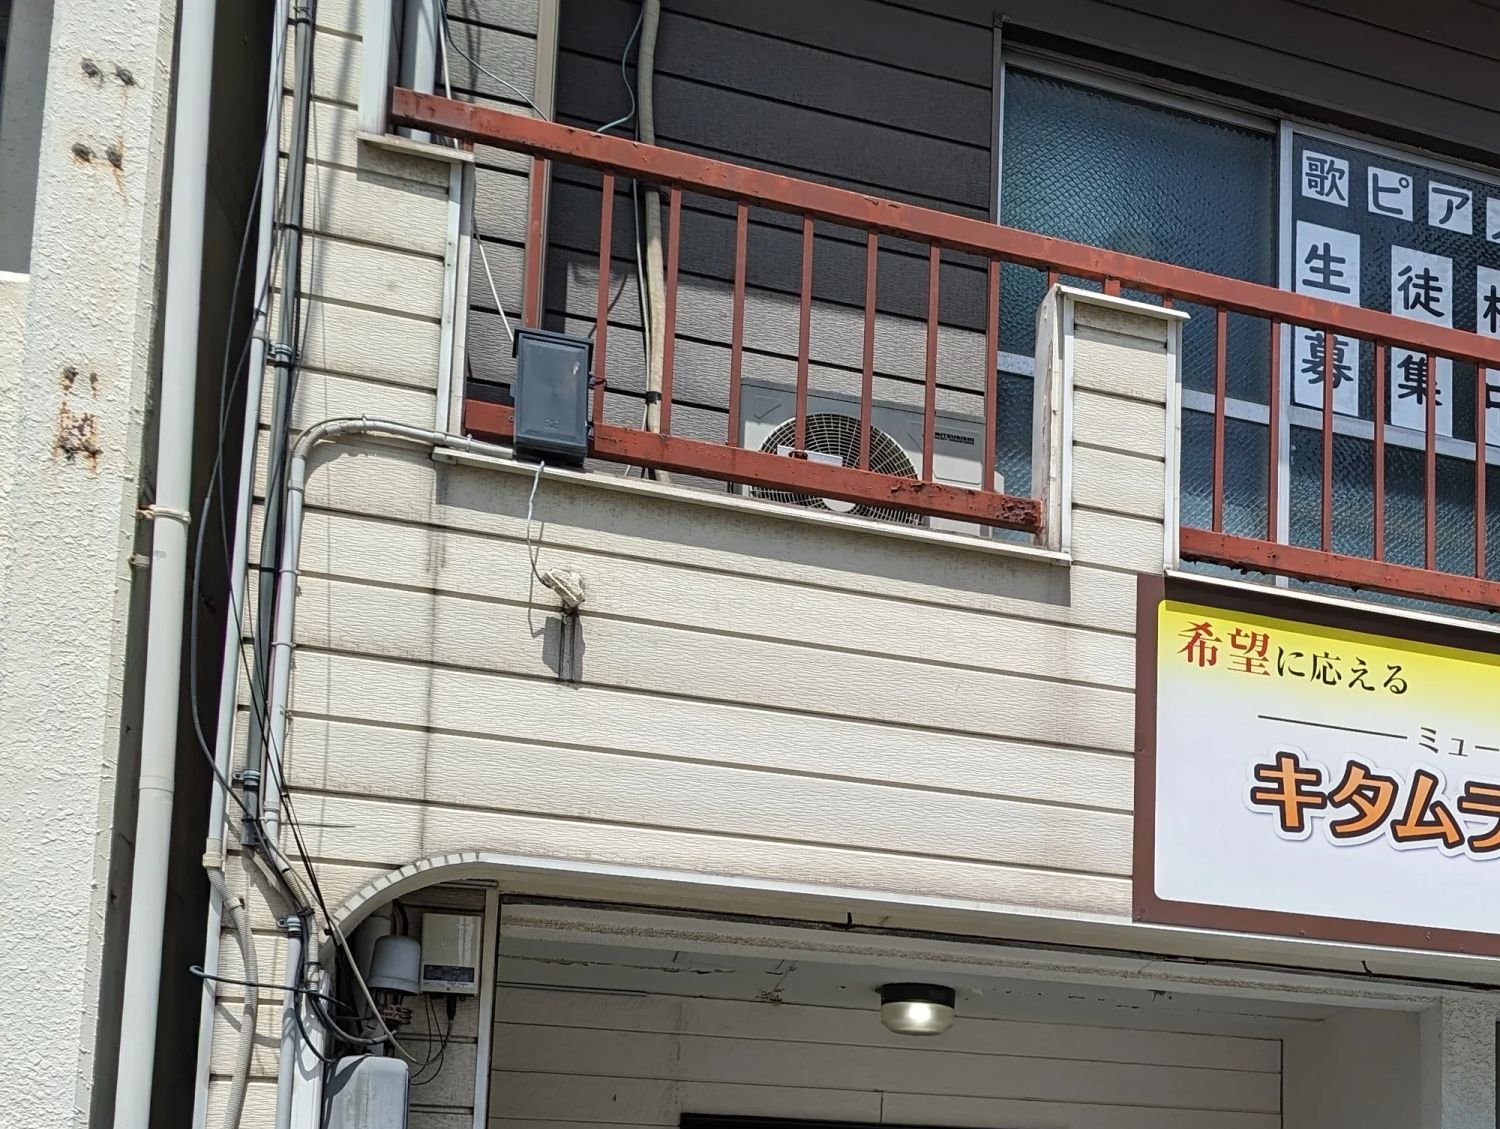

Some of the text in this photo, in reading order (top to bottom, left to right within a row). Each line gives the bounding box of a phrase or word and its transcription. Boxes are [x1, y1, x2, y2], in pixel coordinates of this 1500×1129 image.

[1177, 621, 1408, 695] 希望に応える
